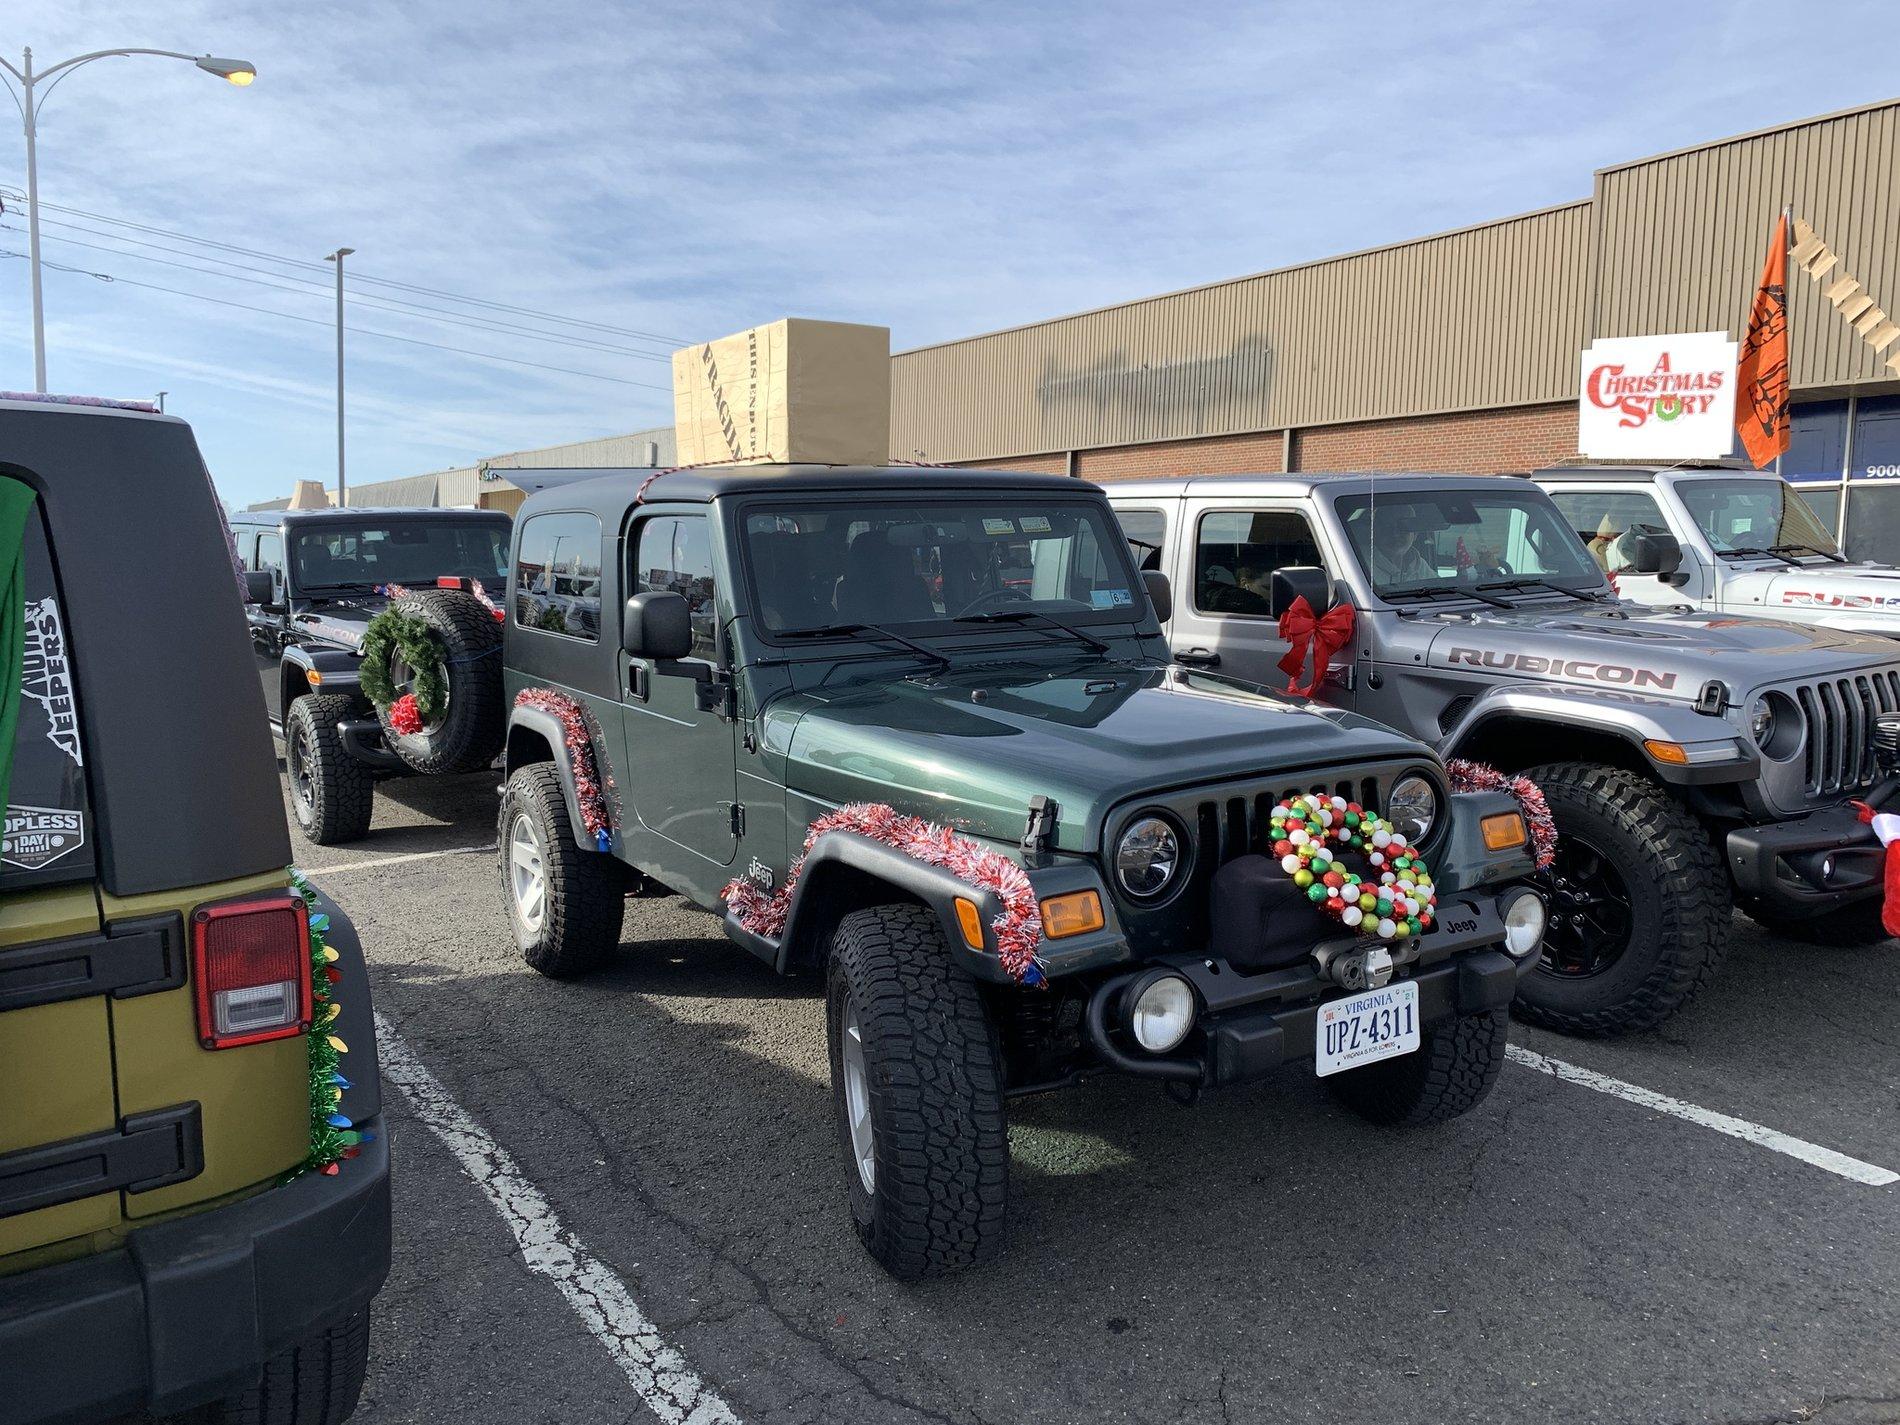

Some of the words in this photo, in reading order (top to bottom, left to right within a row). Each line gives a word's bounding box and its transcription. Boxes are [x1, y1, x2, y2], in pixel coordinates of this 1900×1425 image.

[746, 329, 758, 379] THIS
[1653, 351, 1671, 374] A
[748, 383, 757, 425] END
[39, 614, 78, 756] JEEPERS
[1448, 647, 1677, 690] RUBICON
[3, 814, 78, 833] OPLESS
[20, 834, 45, 847] DAY
[749, 855, 773, 889] Jeep
[1446, 919, 1478, 934] Jeep
[1345, 993, 1393, 1015] VIRGINIA
[1325, 1003, 1413, 1056] UPZ-4311
